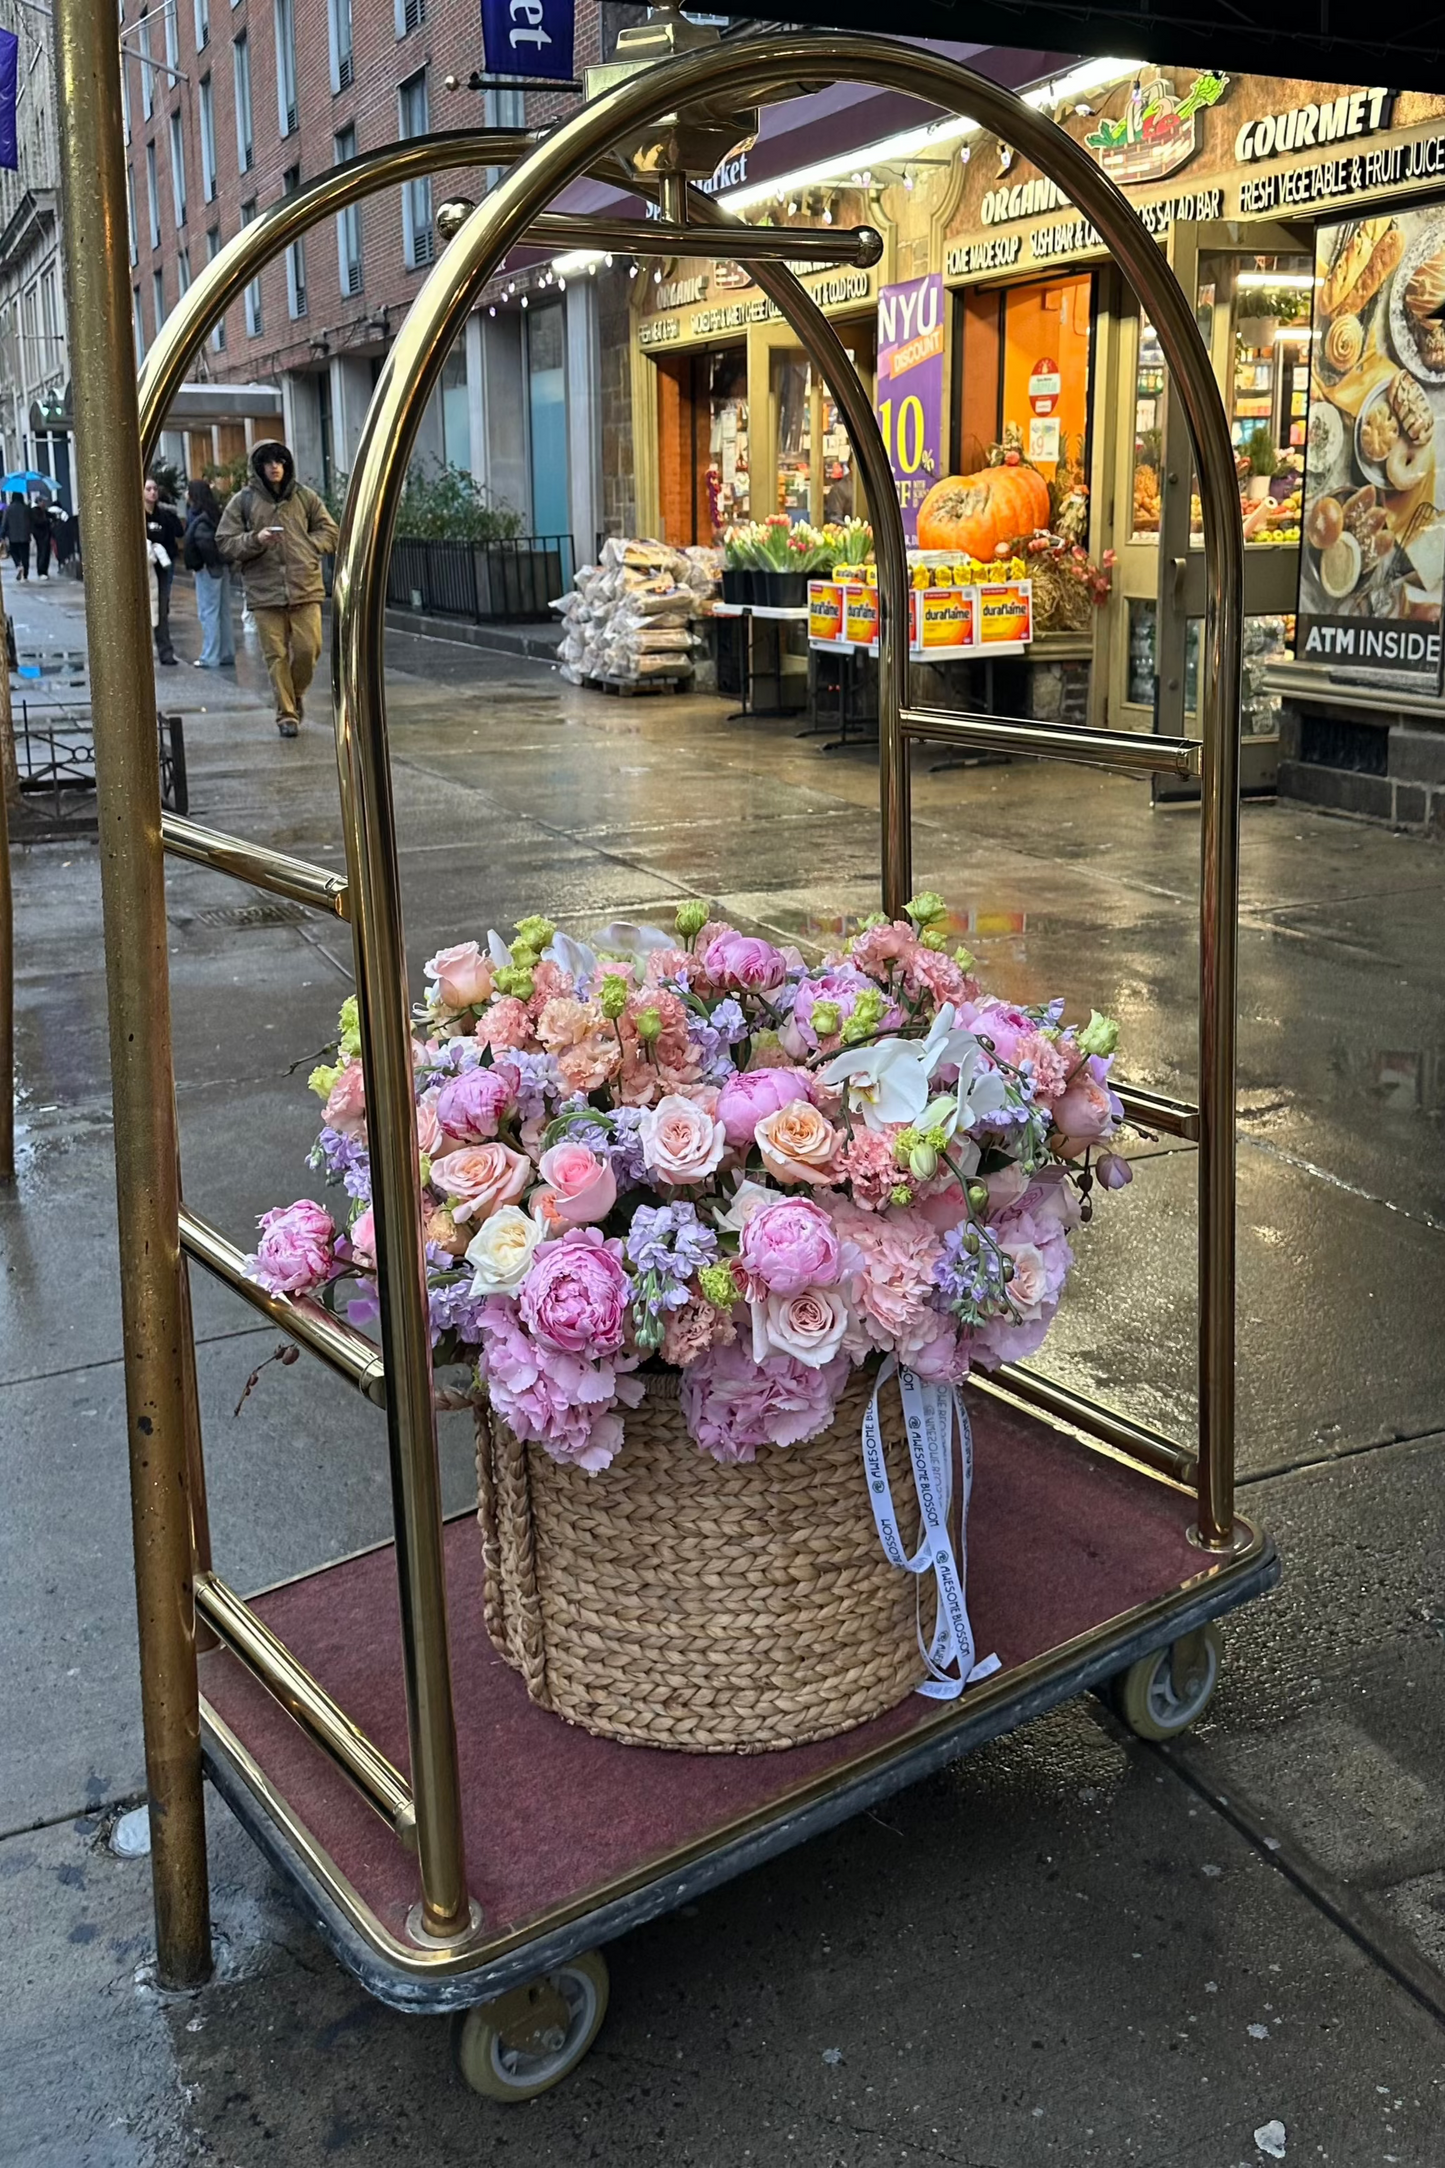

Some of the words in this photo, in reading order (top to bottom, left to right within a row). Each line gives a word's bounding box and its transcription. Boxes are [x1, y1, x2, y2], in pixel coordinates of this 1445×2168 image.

[1235, 87, 1389, 163] GOURMET
[691, 152, 748, 194] arket
[1239, 175, 1275, 212] FRESH
[1279, 157, 1348, 204] VEGETABLE
[1350, 154, 1363, 189] &
[1365, 145, 1404, 186] FRUIT
[1406, 135, 1445, 178] JUICE
[1156, 193, 1194, 232] SALAD
[1196, 187, 1220, 221] BAR
[947, 245, 969, 276] HOME
[994, 234, 1019, 267] SOUP
[1055, 222, 1073, 252] BAR
[656, 274, 703, 310] ORGANIC
[847, 271, 868, 299] FOOD
[878, 276, 938, 345] NYU
[894, 331, 941, 373] DISCOUNT
[925, 605, 970, 621] duraflame
[983, 602, 1026, 617] duraflame
[1305, 626, 1356, 655] ATM
[1359, 629, 1441, 662] INSIDE
[865, 1424, 882, 1478] AWESOME
[911, 1431, 930, 1482] AWESOME
[920, 1482, 940, 1528] BLOSSOM
[941, 1566, 960, 1614] AWESOME
[951, 1613, 970, 1657] BLOSSOM
